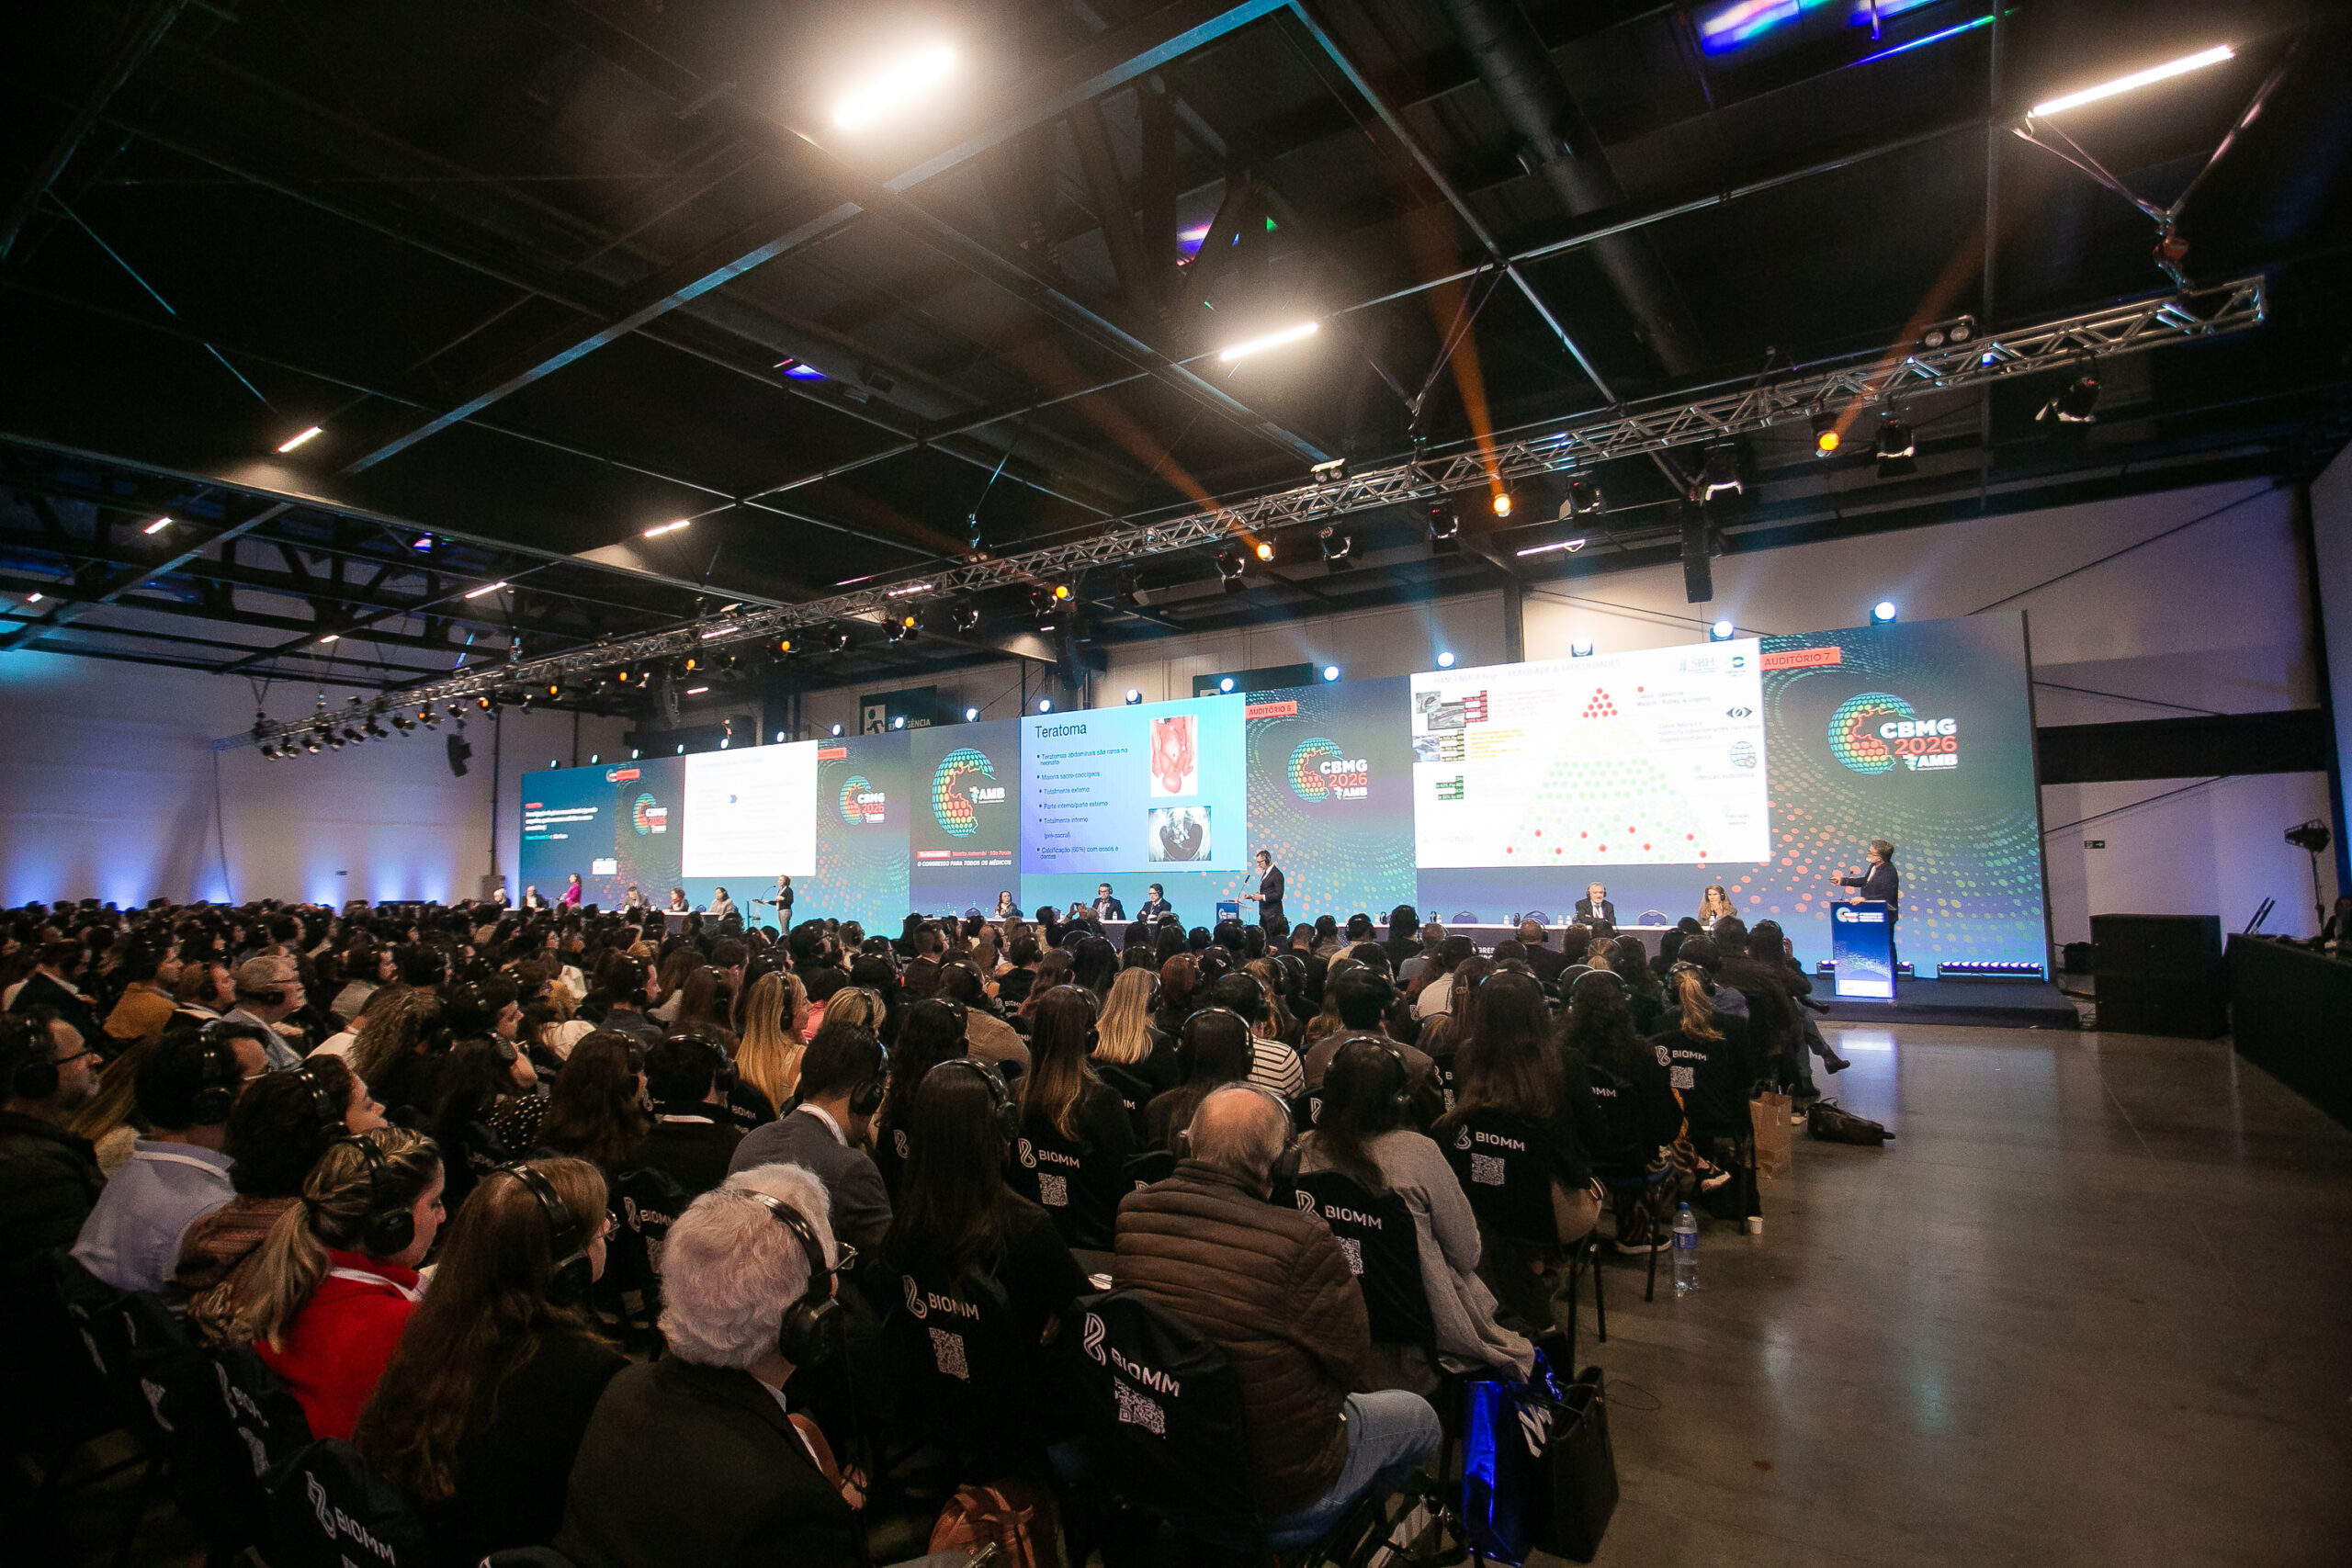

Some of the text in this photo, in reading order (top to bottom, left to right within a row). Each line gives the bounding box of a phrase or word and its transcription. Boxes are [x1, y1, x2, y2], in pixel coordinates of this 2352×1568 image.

[1764, 652, 1821, 666] AUDITÓRIO
[1249, 704, 1285, 715] AUDITÓRIO
[1035, 724, 1087, 739] Teratoma
[1879, 718, 1957, 739] CBMG
[1894, 735, 1957, 756] 2026
[1320, 759, 1368, 774] CBMG
[1917, 754, 1958, 767] AMB
[1328, 773, 1368, 788] 2026
[857, 792, 885, 804] CBMG
[978, 787, 1006, 800] AMB
[1342, 787, 1368, 797] AMB
[861, 803, 884, 814] 2026
[1672, 1049, 1707, 1061] BIOMM
[1475, 1132, 1526, 1152] BIOMM
[1038, 1149, 1080, 1169] BIOMM
[1324, 1205, 1382, 1230] BIOMM
[1111, 1347, 1181, 1398] BIOMM
[334, 1506, 396, 1567] BIOMM
